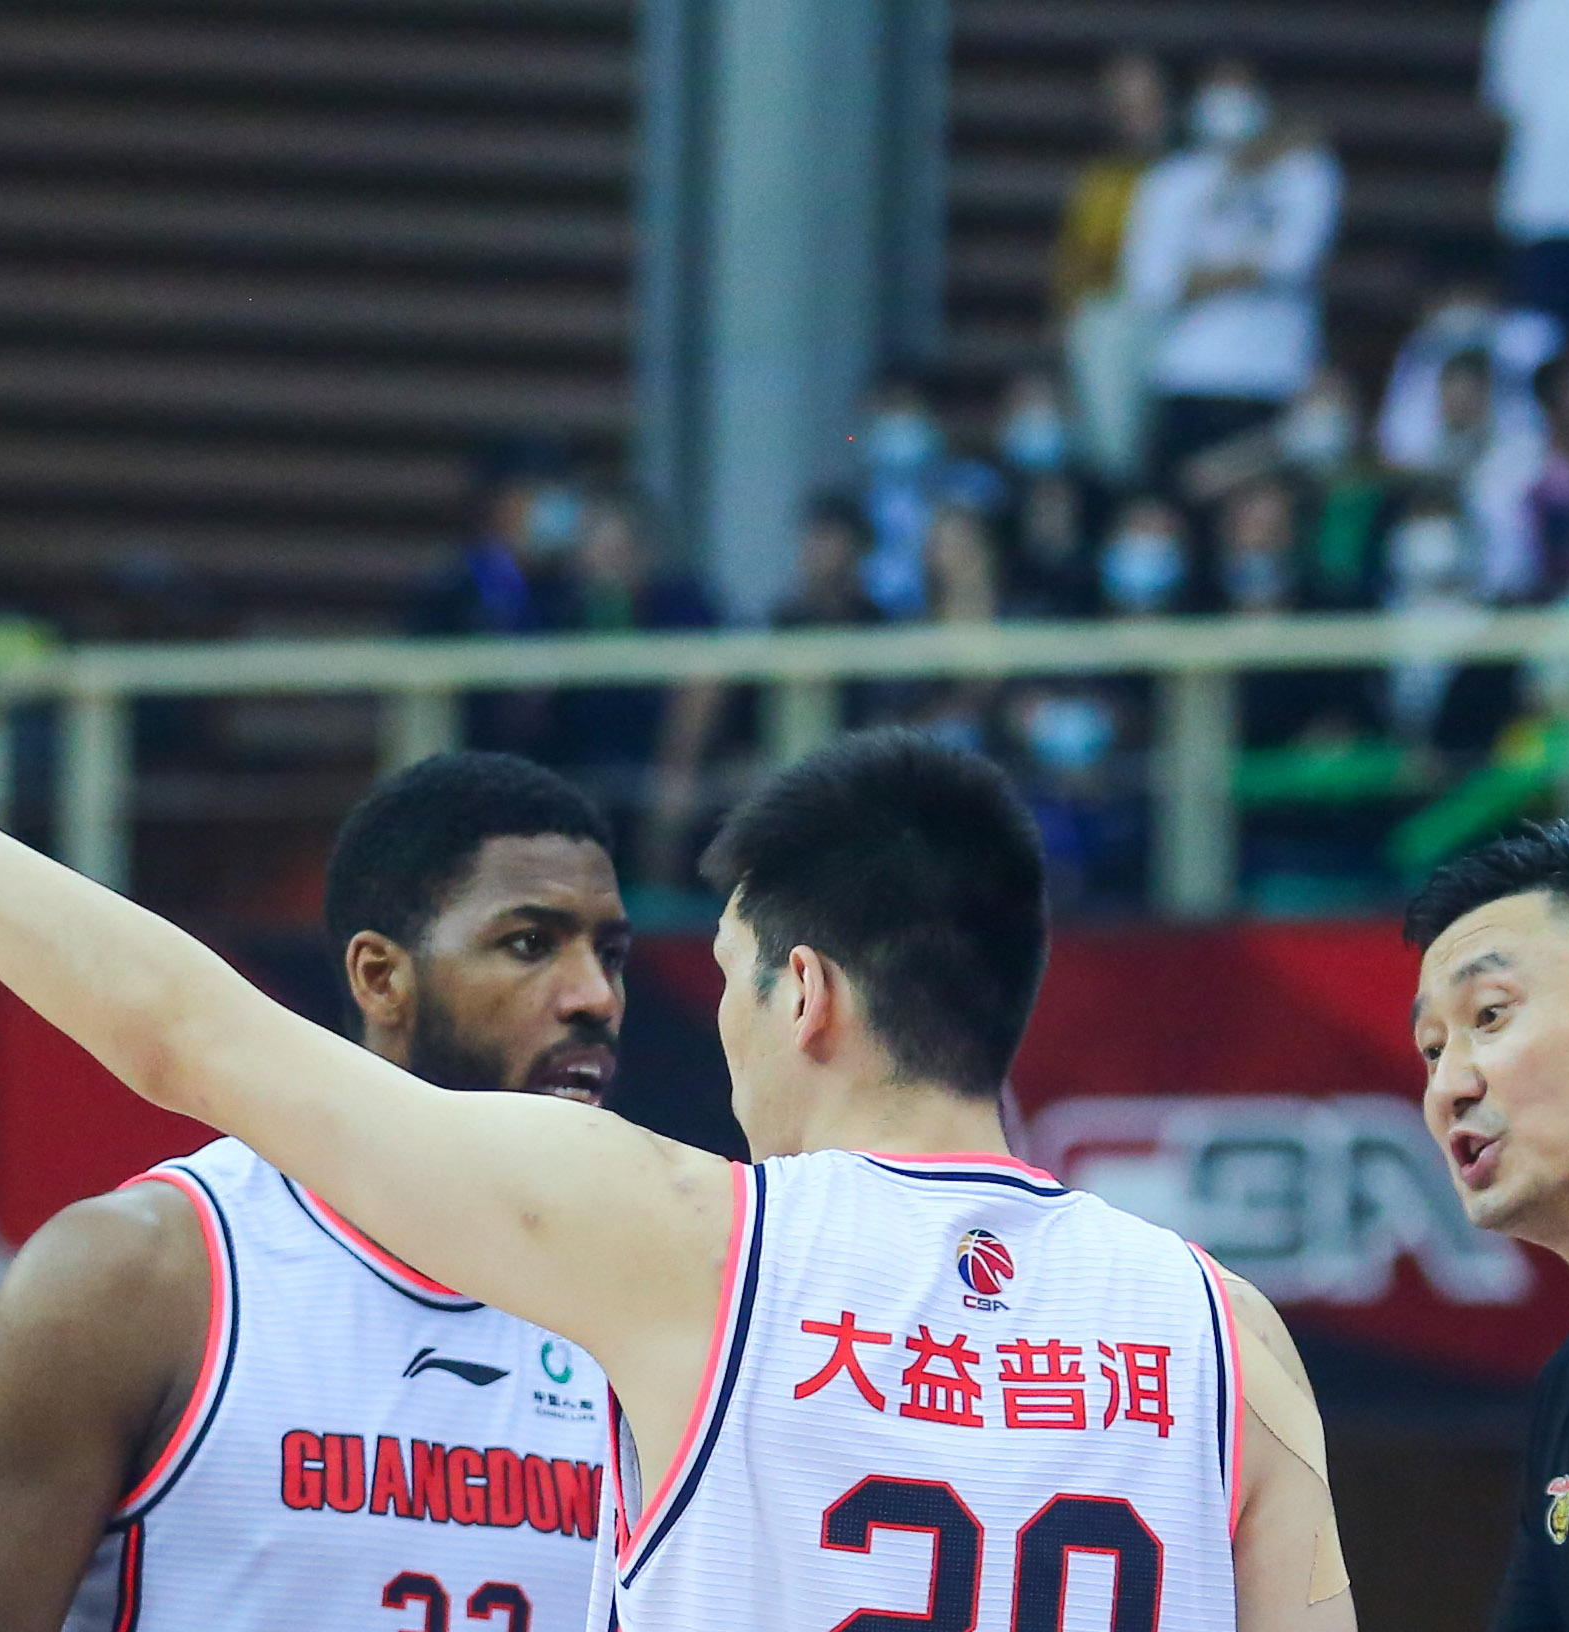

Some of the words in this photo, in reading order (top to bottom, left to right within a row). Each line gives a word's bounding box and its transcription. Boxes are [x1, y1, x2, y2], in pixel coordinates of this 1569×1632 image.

[963, 1294, 1011, 1312] CBA
[794, 1310, 1175, 1438] 大益普洱
[281, 1430, 603, 1540] GUANGDON
